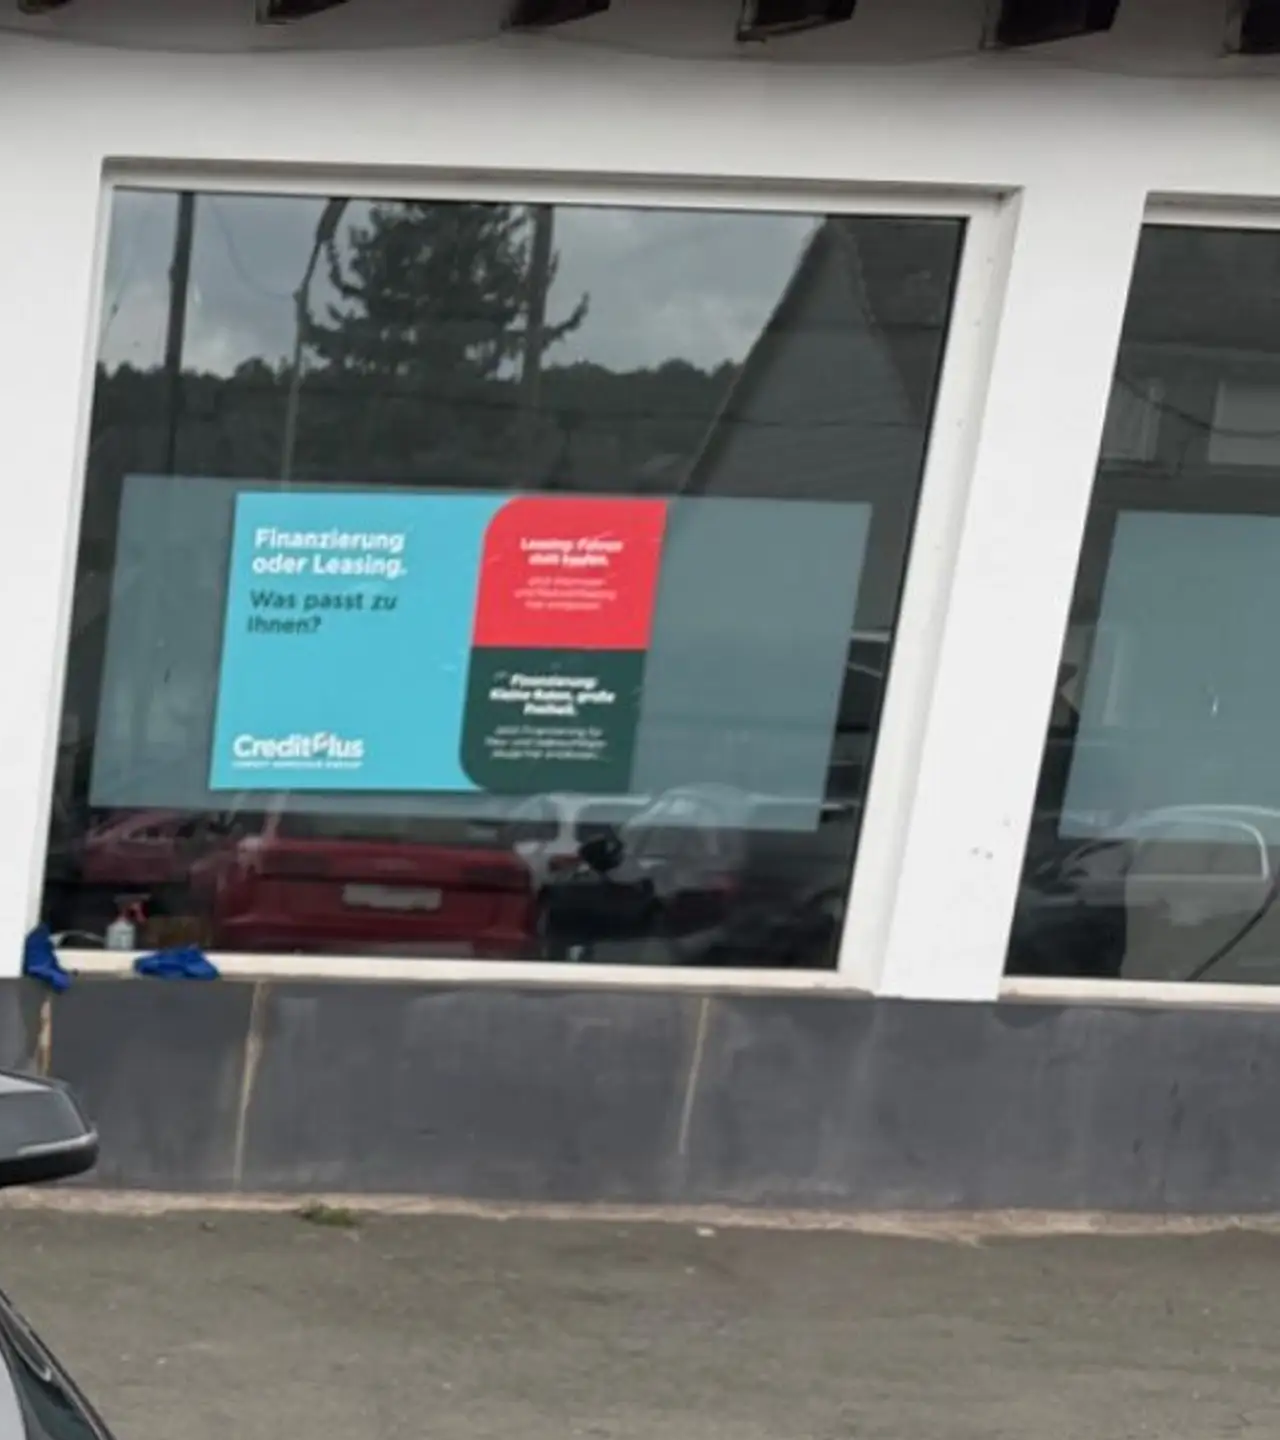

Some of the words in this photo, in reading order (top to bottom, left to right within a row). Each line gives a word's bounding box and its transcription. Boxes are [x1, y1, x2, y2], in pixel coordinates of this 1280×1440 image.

[254, 527, 406, 553] Finanzierung
[252, 553, 308, 575] oder
[312, 553, 407, 579] Leasing.
[249, 590, 296, 609] Was
[302, 592, 364, 612] passt
[370, 594, 398, 610] zu
[246, 615, 322, 634] Ihnen?
